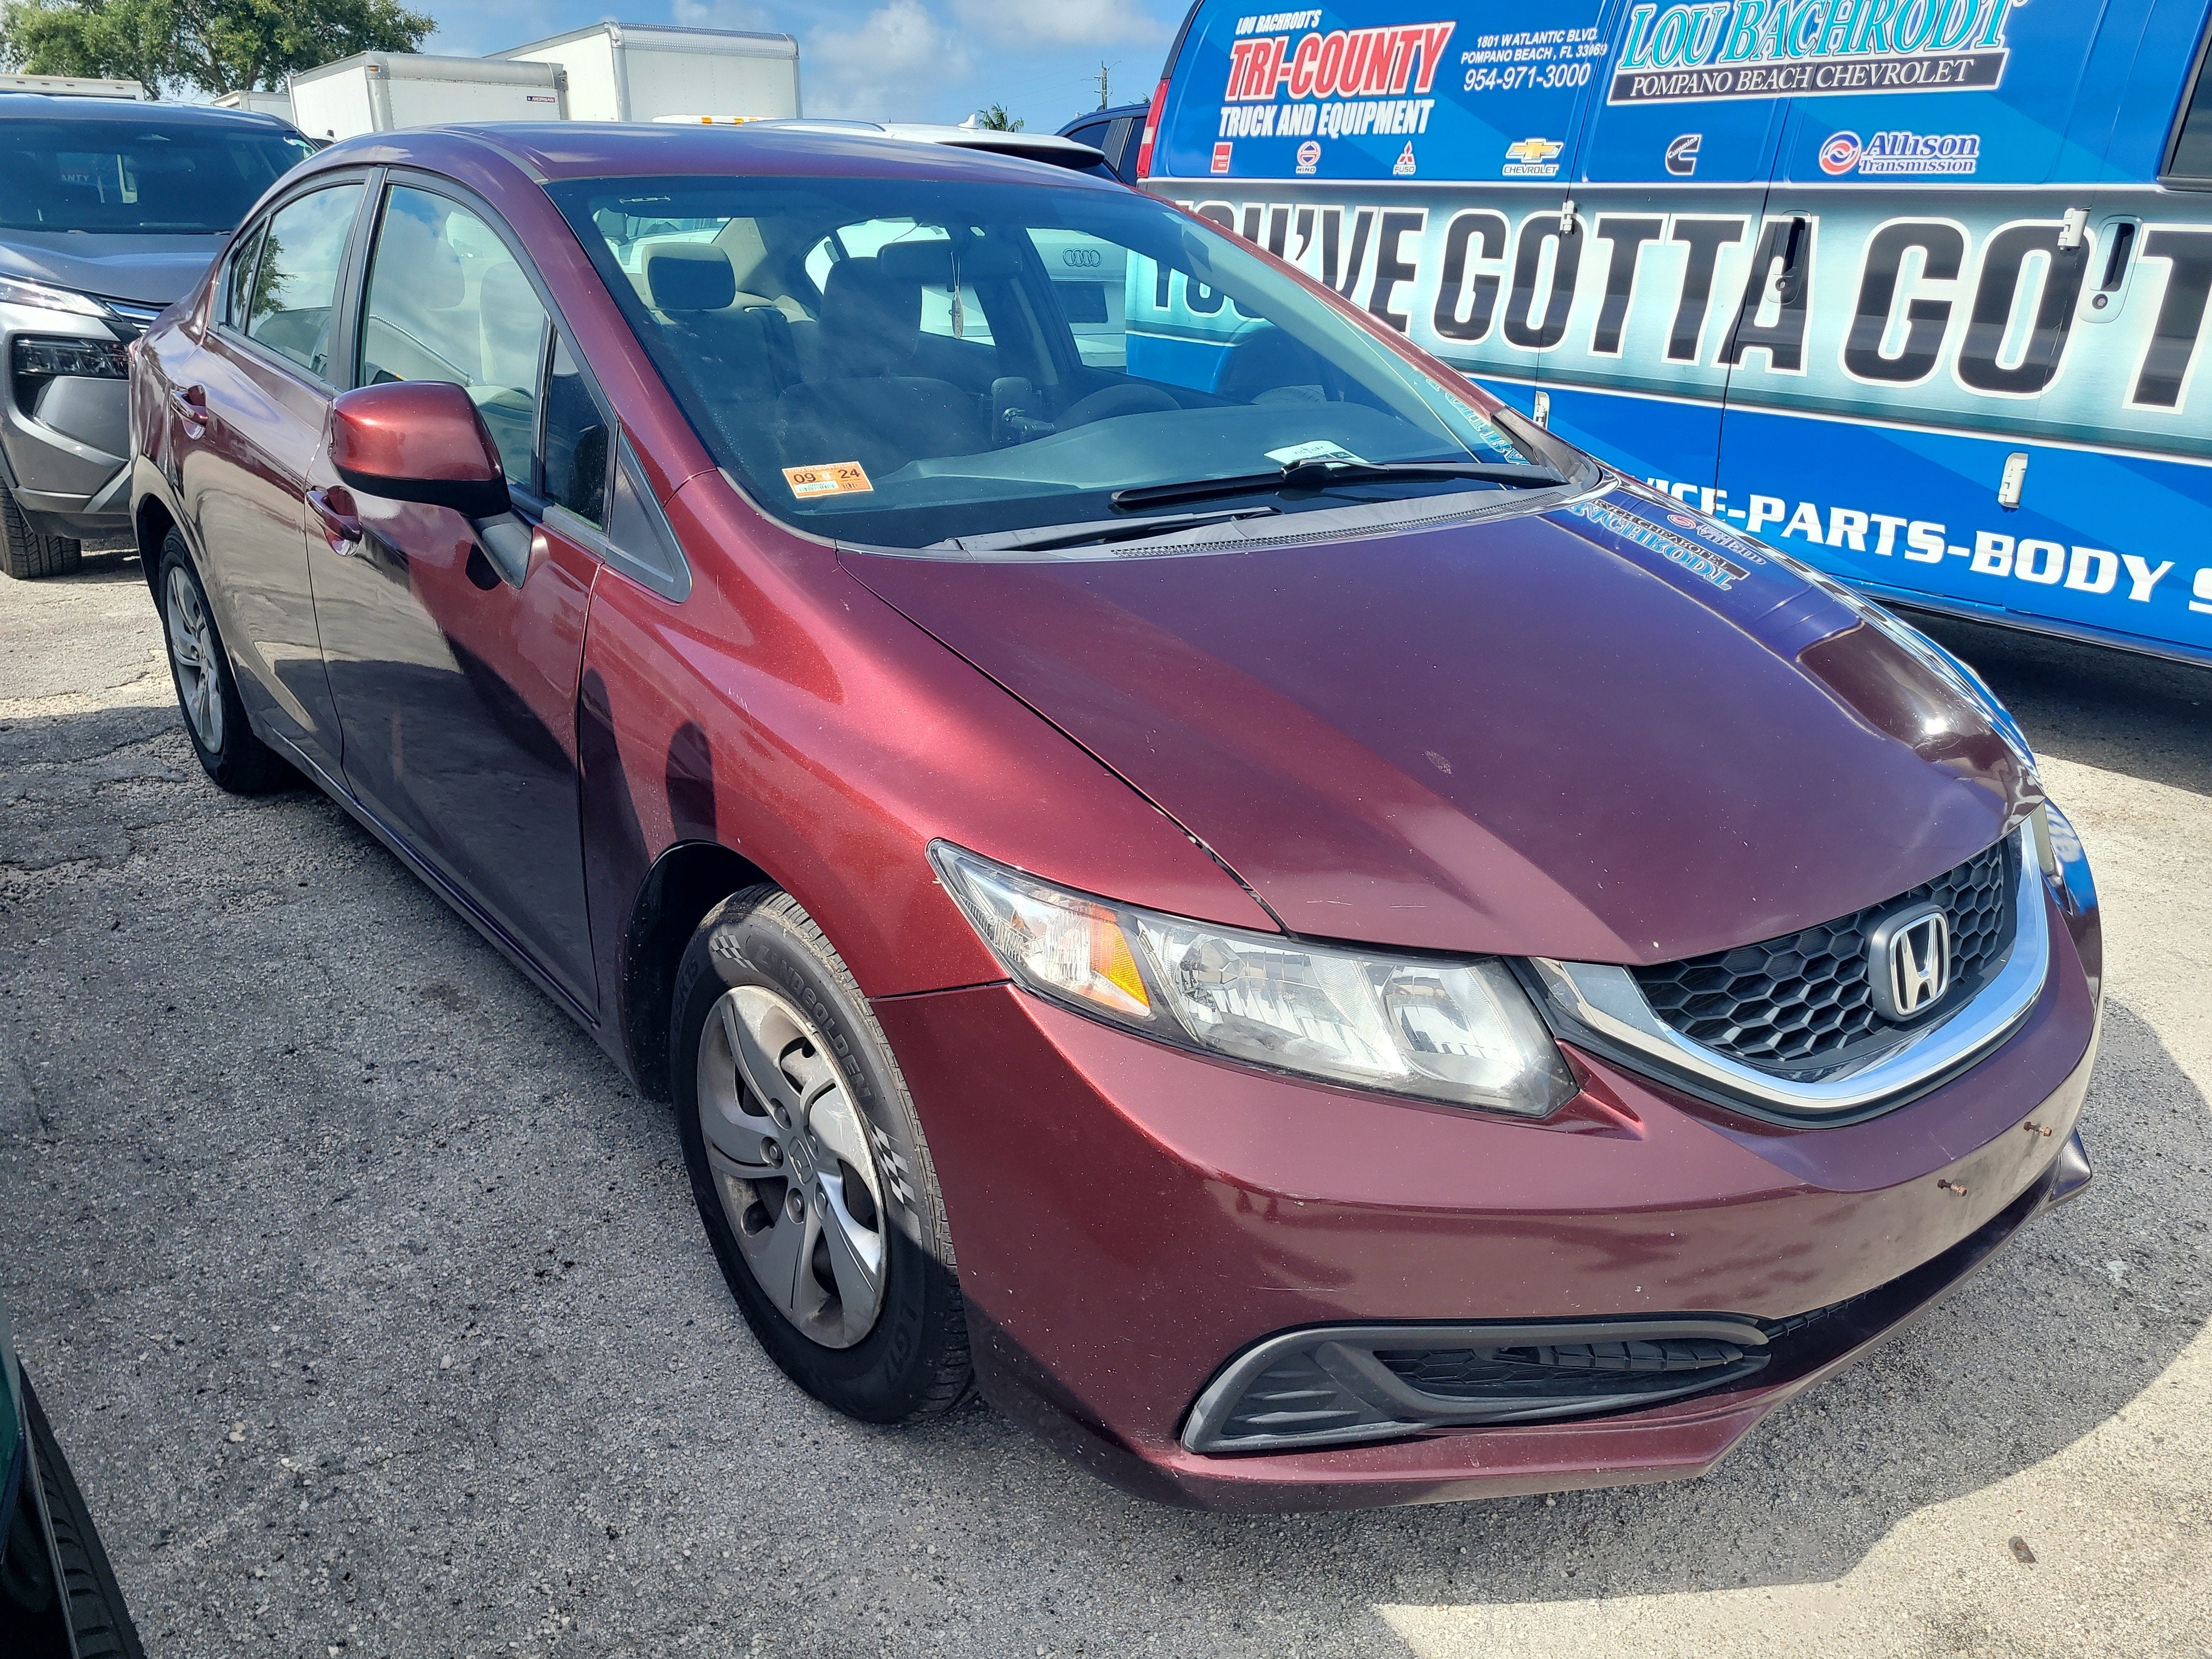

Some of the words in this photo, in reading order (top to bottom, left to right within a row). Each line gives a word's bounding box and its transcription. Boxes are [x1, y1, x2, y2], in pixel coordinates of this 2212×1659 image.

[1235, 16, 1255, 35] LOU
[1256, 9, 1322, 33] BACHRODT'S
[1477, 35, 1499, 48] 1801
[1566, 28, 1598, 42] BLVD.
[1619, 4, 1729, 69] LOU
[1720, 0, 2024, 62] BACHRODT
[1224, 21, 1457, 101] TRI-COUNTY
[1460, 49, 1513, 64] POMPANO
[1559, 46, 1573, 59] FL
[1576, 43, 1609, 56] 33069
[1463, 63, 1591, 92] 954-971-3000
[1630, 71, 1733, 97] POMPANO
[1735, 65, 1813, 92] BEACH
[1816, 58, 1974, 88] CHEVROLET
[1218, 105, 1279, 138] TRUCK
[1276, 103, 1318, 136] AND
[1317, 98, 1436, 139] EQUIPMENT
[1668, 137, 1698, 159] Cummins
[1865, 134, 1977, 156] Allison
[1503, 165, 1557, 174] CHEVROLET
[1860, 159, 1973, 172] Transmission
[1434, 208, 1820, 377] GOTTA
[1837, 217, 2097, 401] GO
[793, 472, 816, 484] 09
[837, 468, 861, 479] 24
